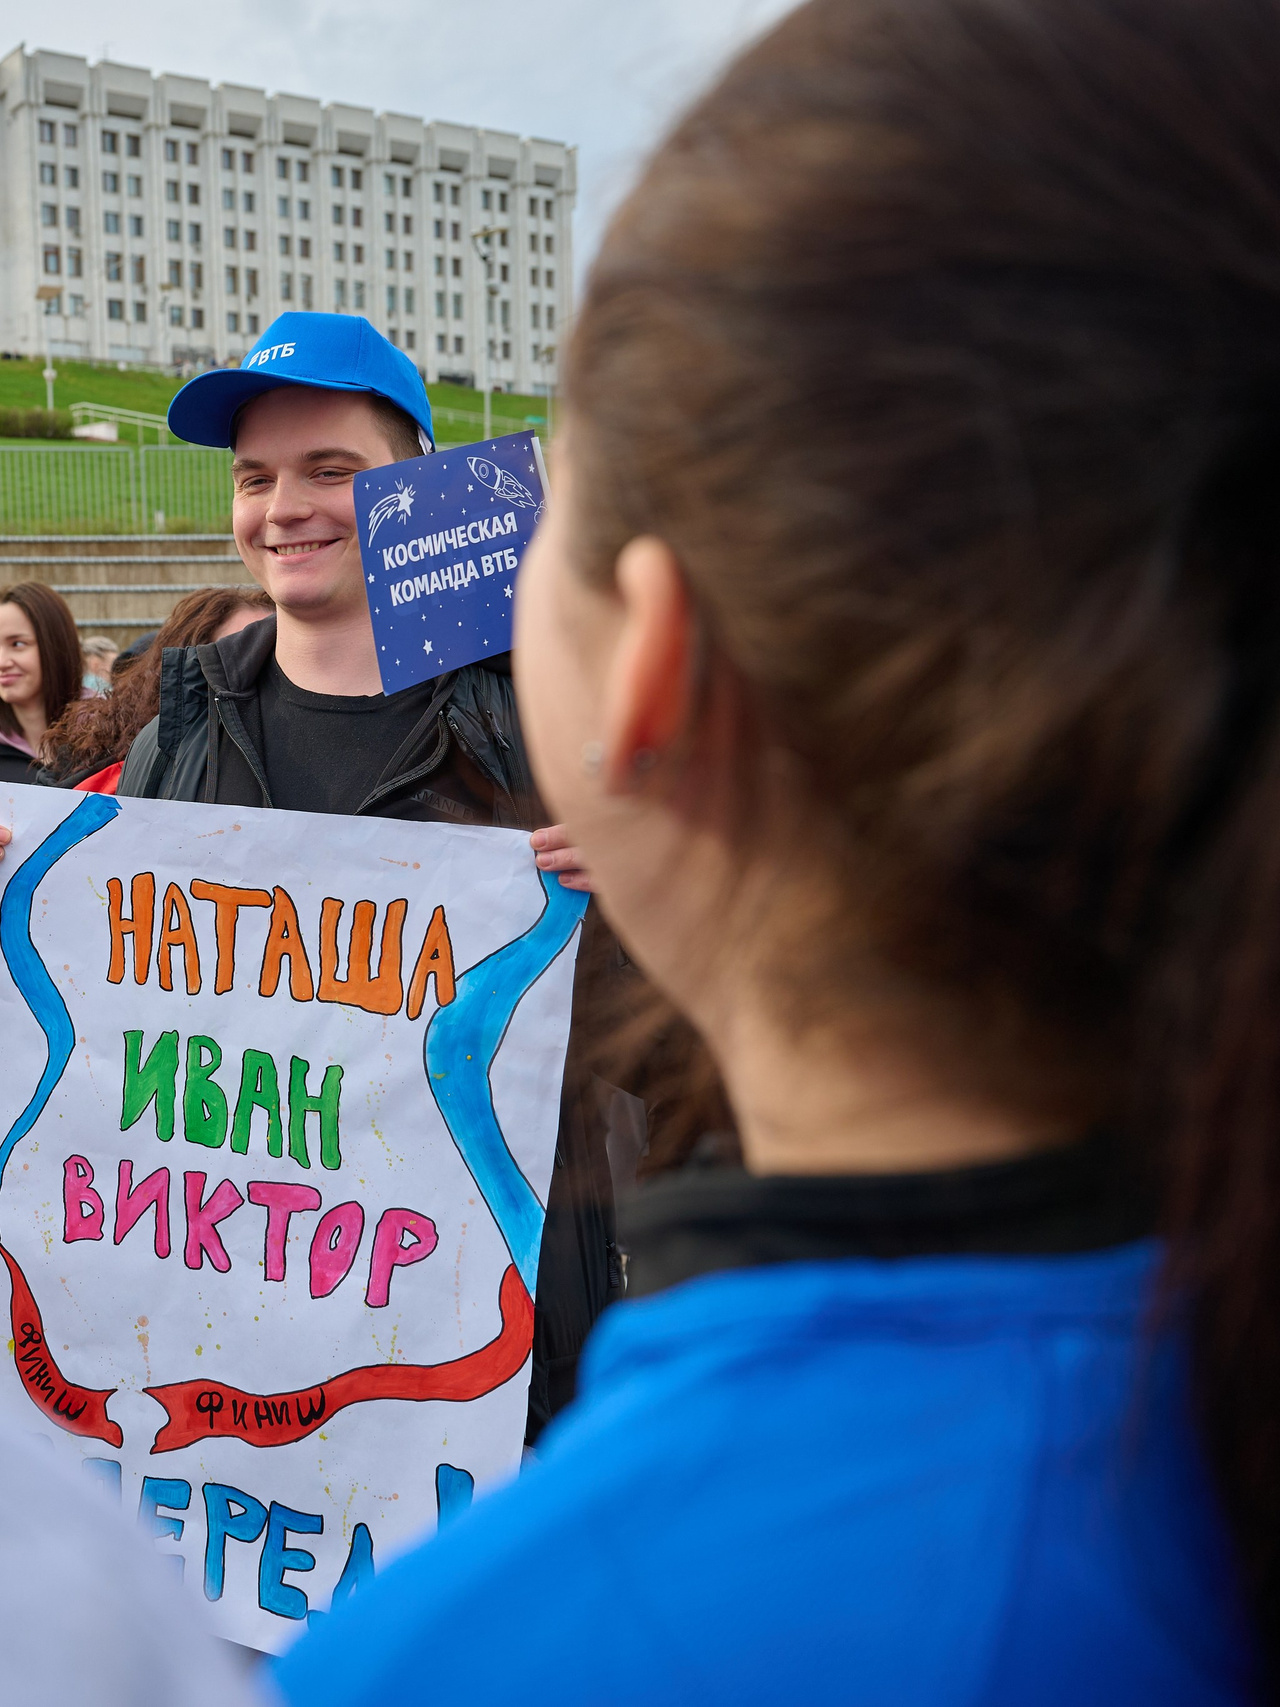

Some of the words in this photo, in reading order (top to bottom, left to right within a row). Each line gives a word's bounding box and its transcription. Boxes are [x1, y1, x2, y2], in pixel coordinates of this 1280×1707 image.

[258, 342, 297, 366] ВТБ
[382, 511, 518, 571] КОСМИЧЕСКАЯ
[390, 559, 480, 607] КОМАНДА
[480, 547, 519, 577] ВТБ
[106, 872, 457, 1020] НАТАША
[119, 1029, 344, 1171] ИВАН
[62, 1154, 439, 1308] ВИКТОР
[19, 1322, 88, 1421] ФИНИШ
[195, 1387, 326, 1430] ФИНИШ
